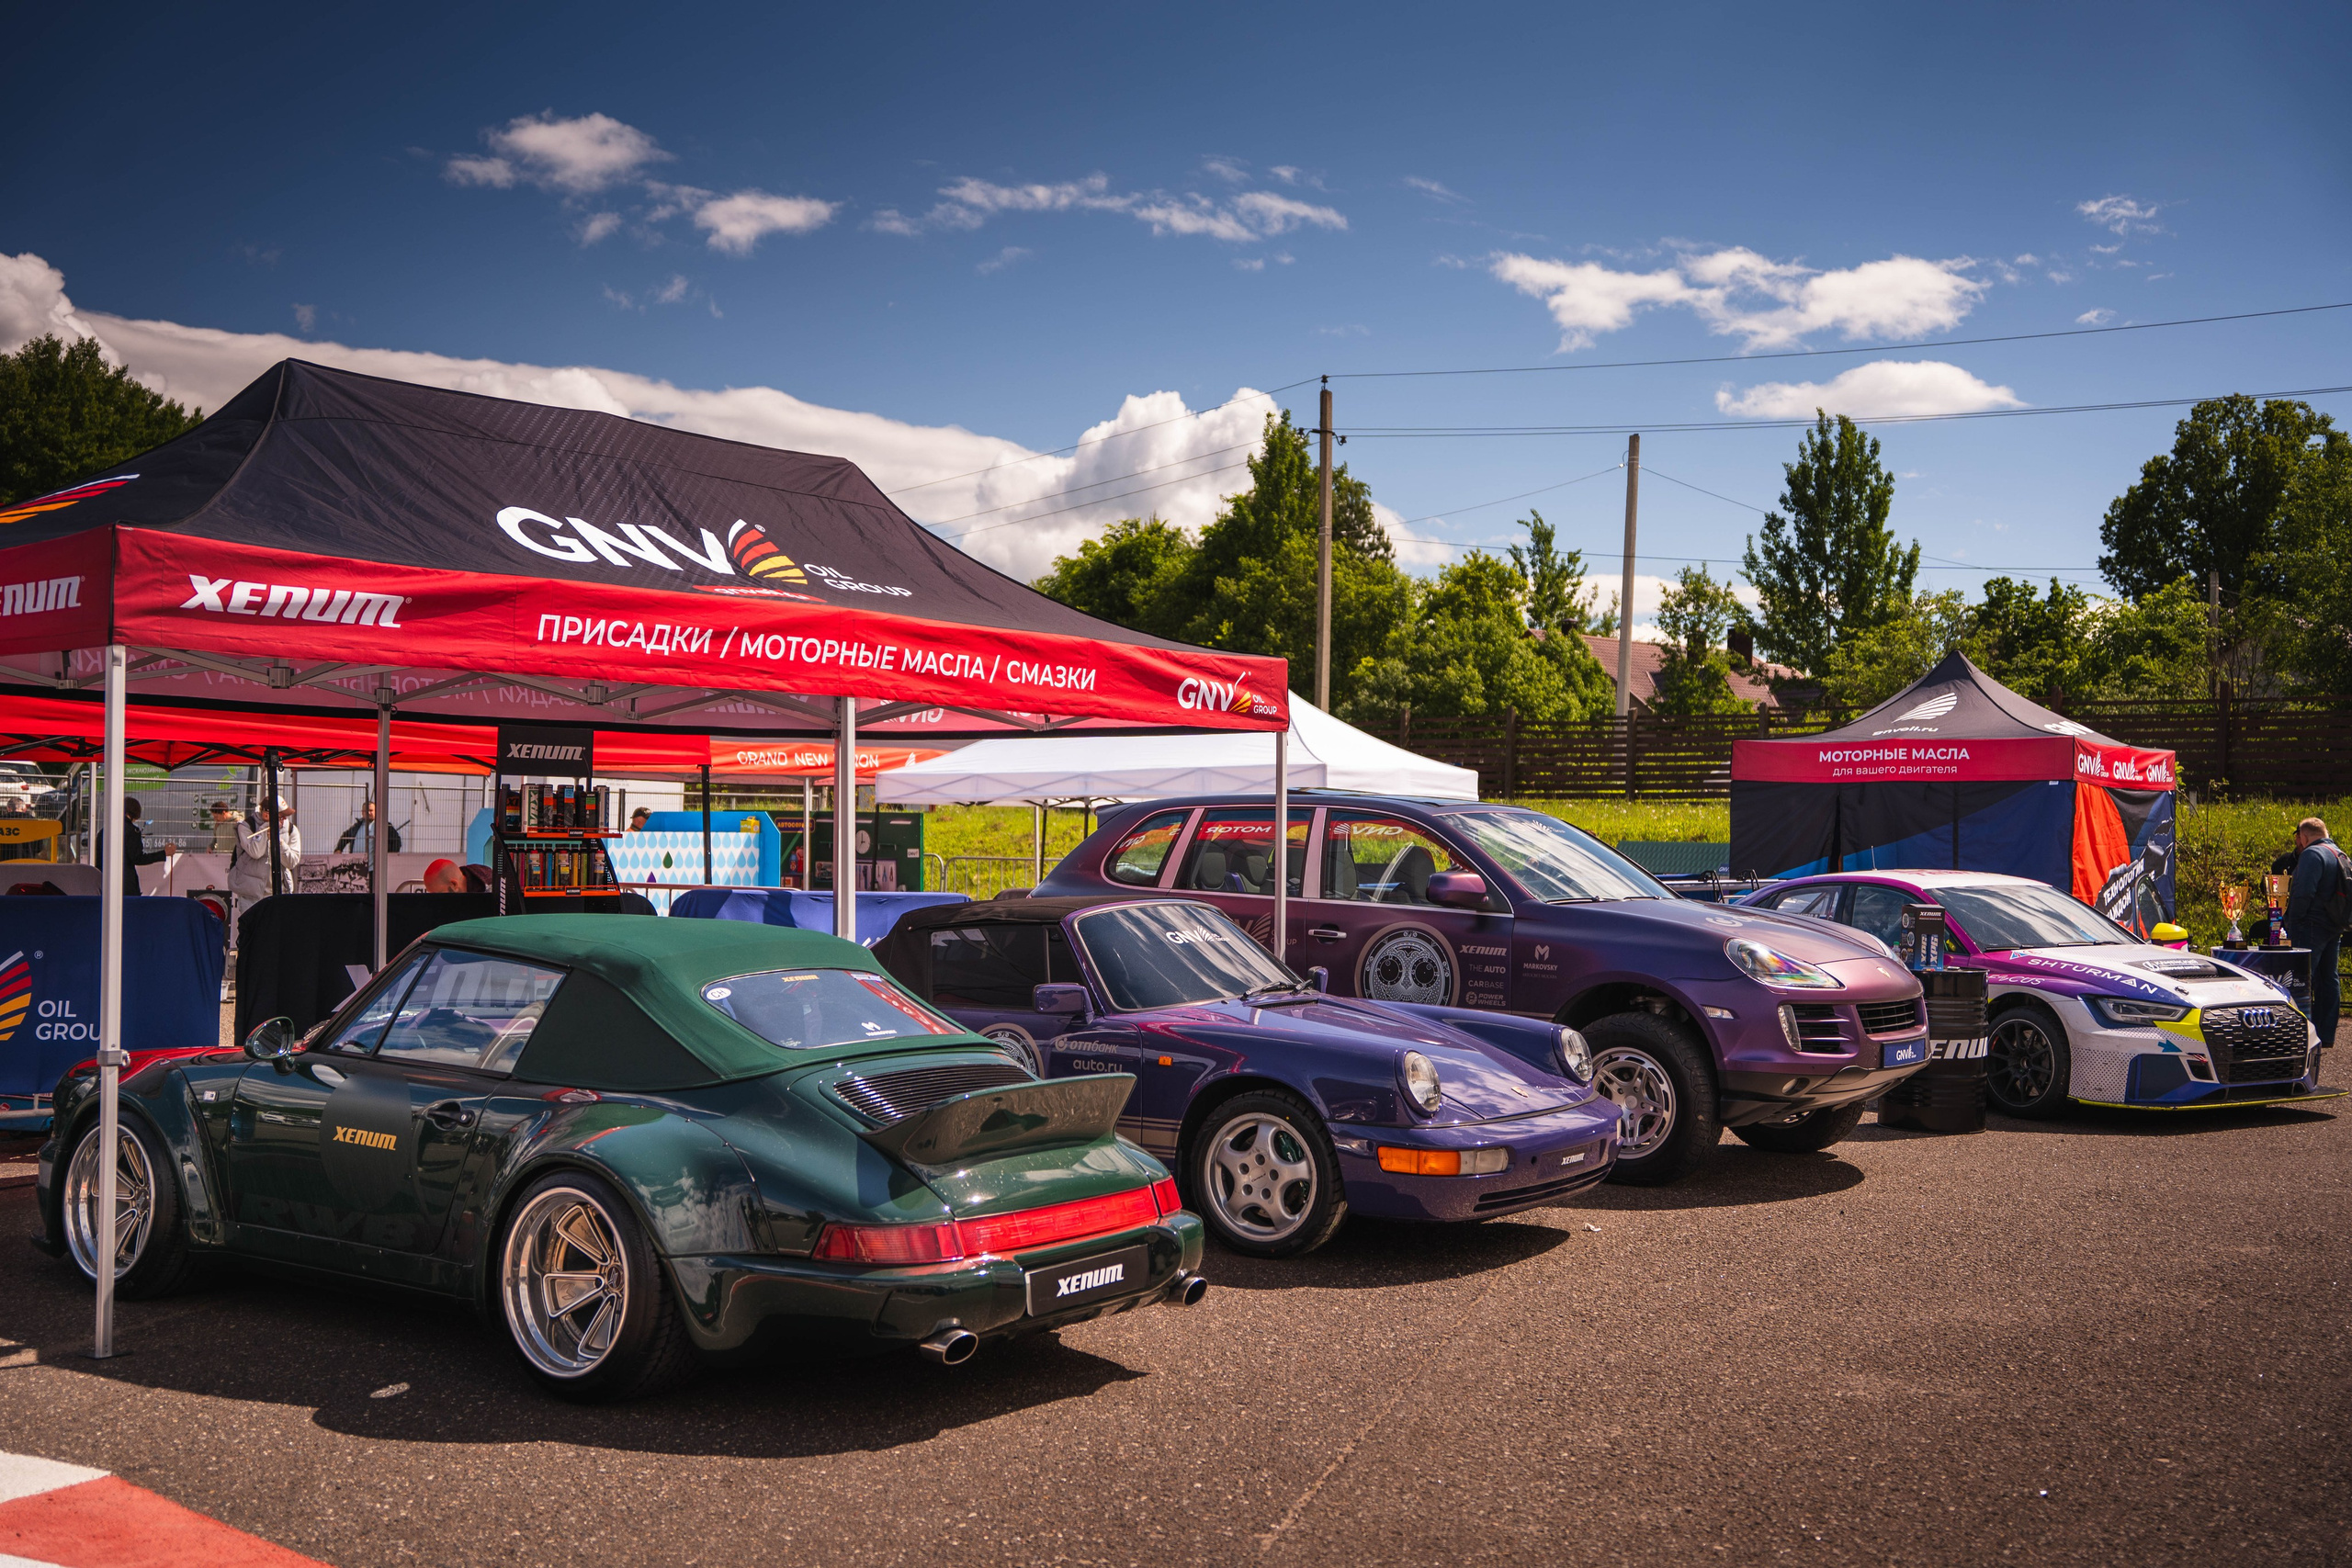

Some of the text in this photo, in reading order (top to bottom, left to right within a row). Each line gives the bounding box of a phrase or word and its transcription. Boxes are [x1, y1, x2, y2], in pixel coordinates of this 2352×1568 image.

[496, 506, 736, 575] GNV
[804, 563, 853, 580] OIL
[0, 576, 82, 616] NUM
[823, 579, 913, 597] GROUP
[180, 574, 405, 628] XENUM
[537, 614, 713, 655] ПРИСАДКИ
[740, 632, 897, 671] МОТОРНЫЕ
[901, 648, 985, 681] МАСЛА
[1007, 660, 1096, 691] СМАЗКИ
[1177, 677, 1235, 712] GNV
[1252, 694, 1264, 704] OIL
[1253, 705, 1277, 715] GROUP
[507, 743, 583, 761] XENUM
[737, 751, 787, 766] GRAND
[795, 752, 827, 768] NEW
[1819, 748, 1970, 762] МОТОРНЫЕ МАСЛА
[1832, 765, 1958, 777] для вашего двигателя
[2077, 753, 2096, 775] GNV
[2113, 761, 2132, 780] GNV
[2146, 764, 2163, 782] GNV
[1166, 931, 1204, 944] GNV
[1459, 944, 1507, 956] XENUM
[1469, 964, 1507, 974] THE AUTO
[1523, 963, 1558, 971] MARKOVSKY
[2028, 958, 2158, 994] SHTURMAN
[1468, 980, 1504, 988] CARBASE
[710, 988, 728, 999] CH
[38, 1000, 77, 1018] OIL
[35, 1023, 101, 1041] GROU
[1929, 1037, 1988, 1059] ENU
[1073, 1059, 1122, 1072] auto.ru
[333, 1125, 397, 1151] XENUM
[1561, 1153, 1585, 1165] XENUM
[1057, 1264, 1125, 1298] XENUM
